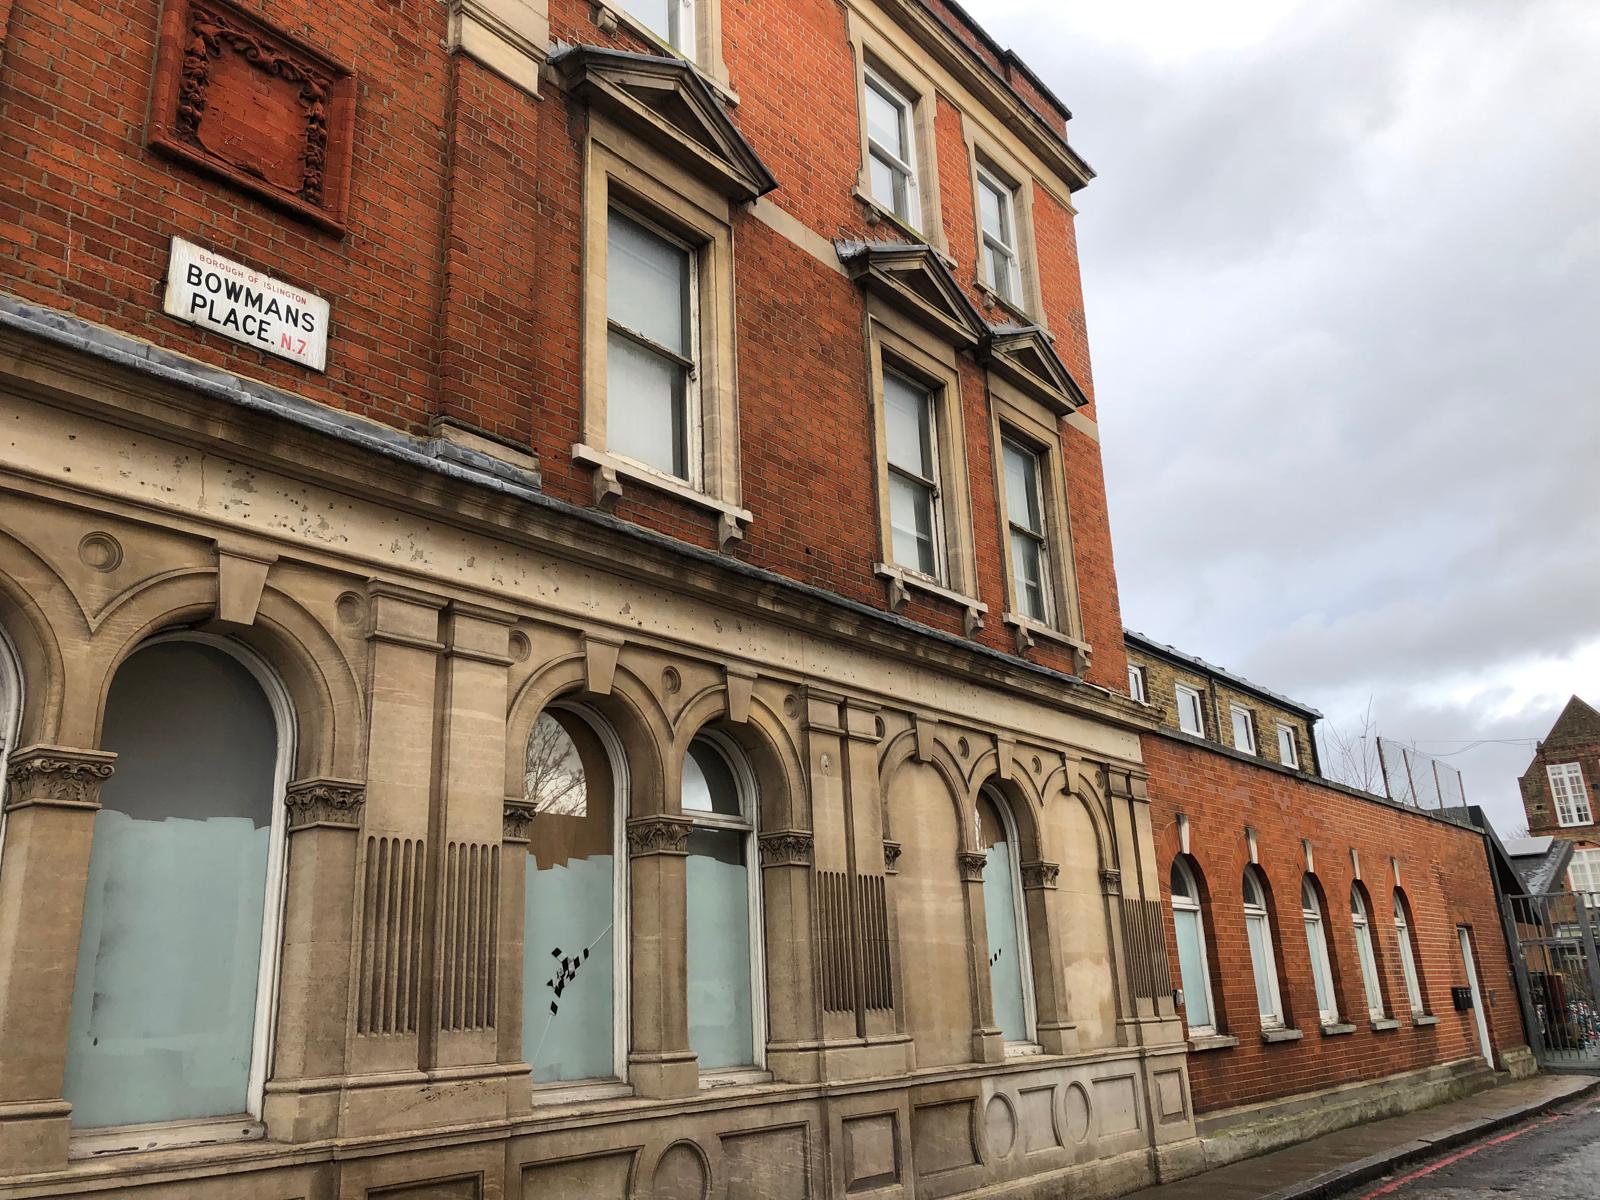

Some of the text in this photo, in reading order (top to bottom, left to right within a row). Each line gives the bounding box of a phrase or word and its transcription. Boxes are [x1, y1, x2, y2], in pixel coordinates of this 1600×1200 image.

[186, 263, 315, 333] BOWMANS
[199, 254, 307, 305] BOROUGH OF ISLINGTON
